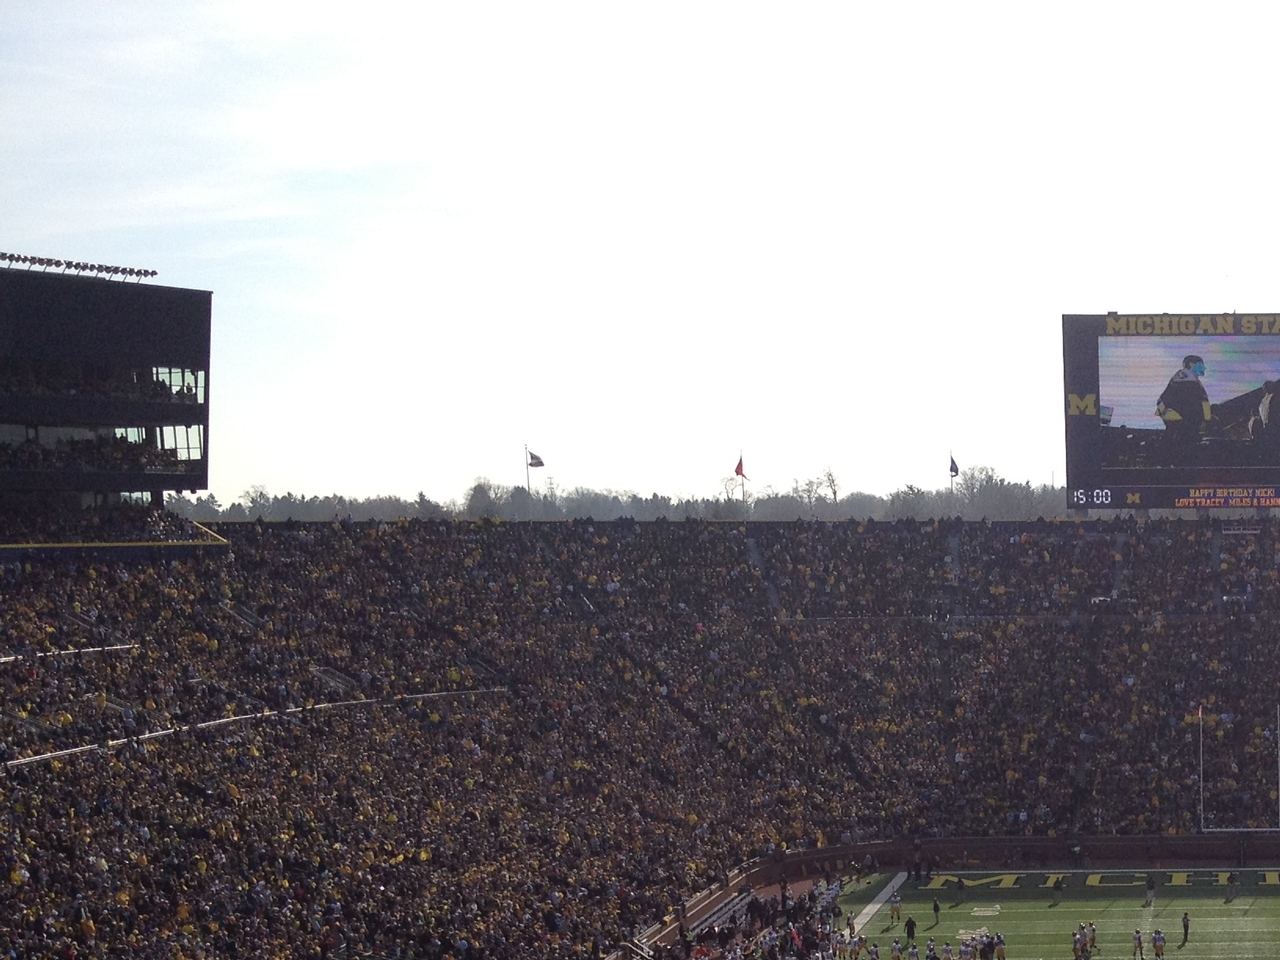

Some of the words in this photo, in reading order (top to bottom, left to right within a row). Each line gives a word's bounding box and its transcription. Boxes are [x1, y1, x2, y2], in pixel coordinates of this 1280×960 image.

[1106, 315, 1234, 334] MICHIGAN
[1068, 393, 1097, 416] M
[1073, 489, 1111, 504] 15:00
[1189, 488, 1214, 497] HAPPY
[1216, 488, 1253, 497] BIRTHDAY
[1175, 498, 1194, 507] LOVE
